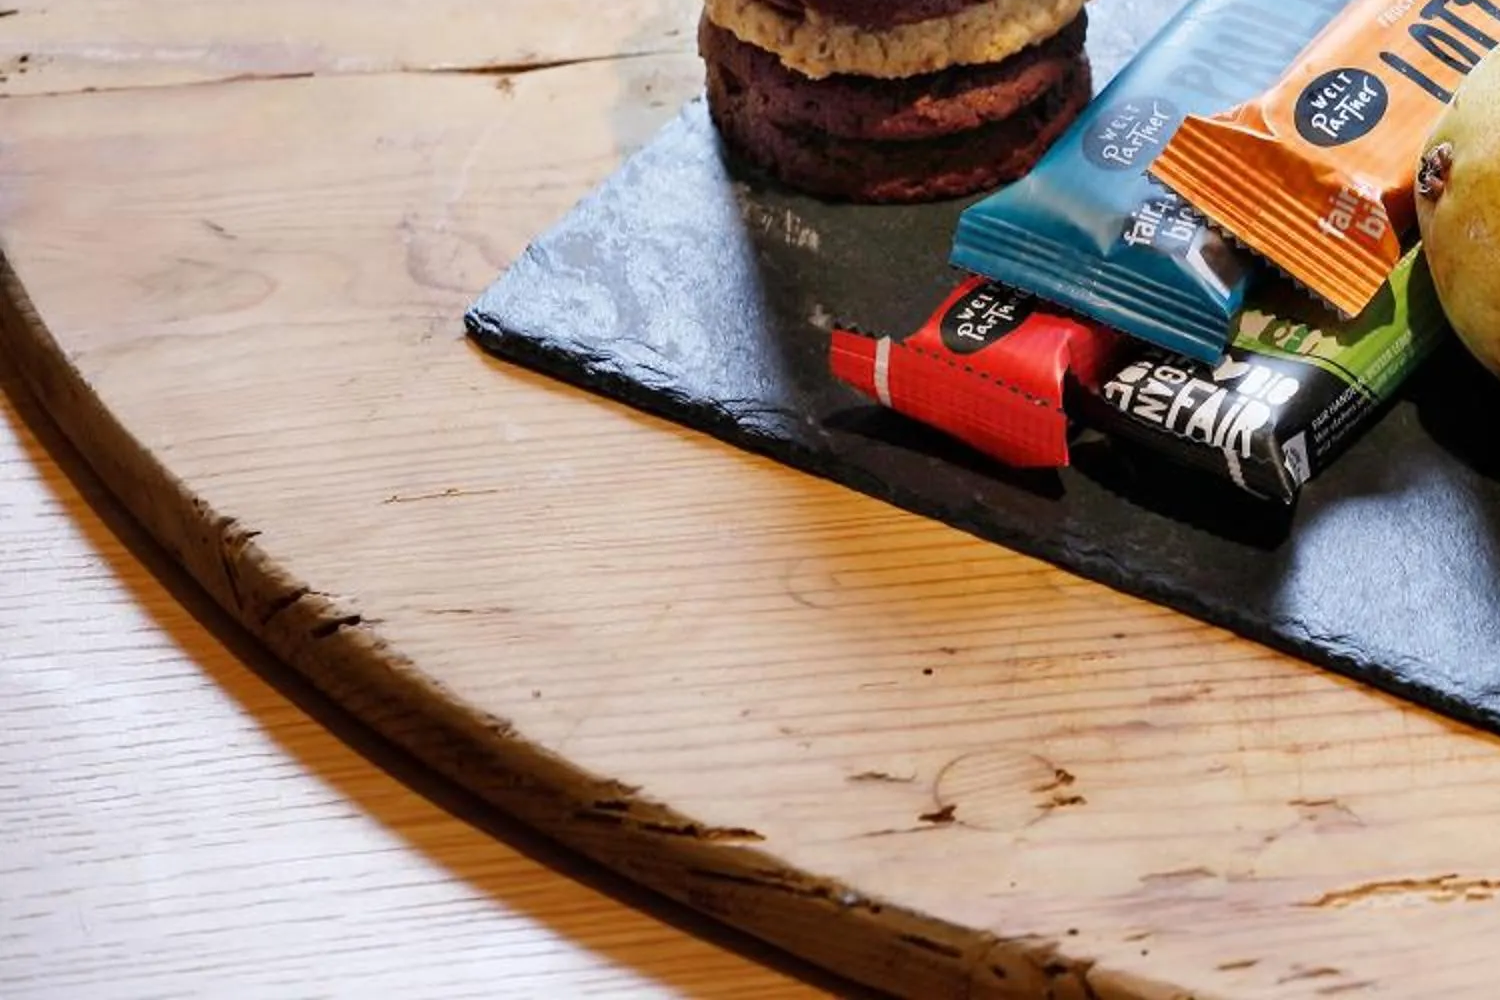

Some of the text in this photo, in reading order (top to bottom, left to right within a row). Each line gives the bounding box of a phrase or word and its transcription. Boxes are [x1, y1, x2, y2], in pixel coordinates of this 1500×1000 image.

[1310, 71, 1352, 109] WELT
[1123, 203, 1163, 246] fair
[1317, 184, 1360, 240] fair
[1165, 377, 1272, 460] FAIR
